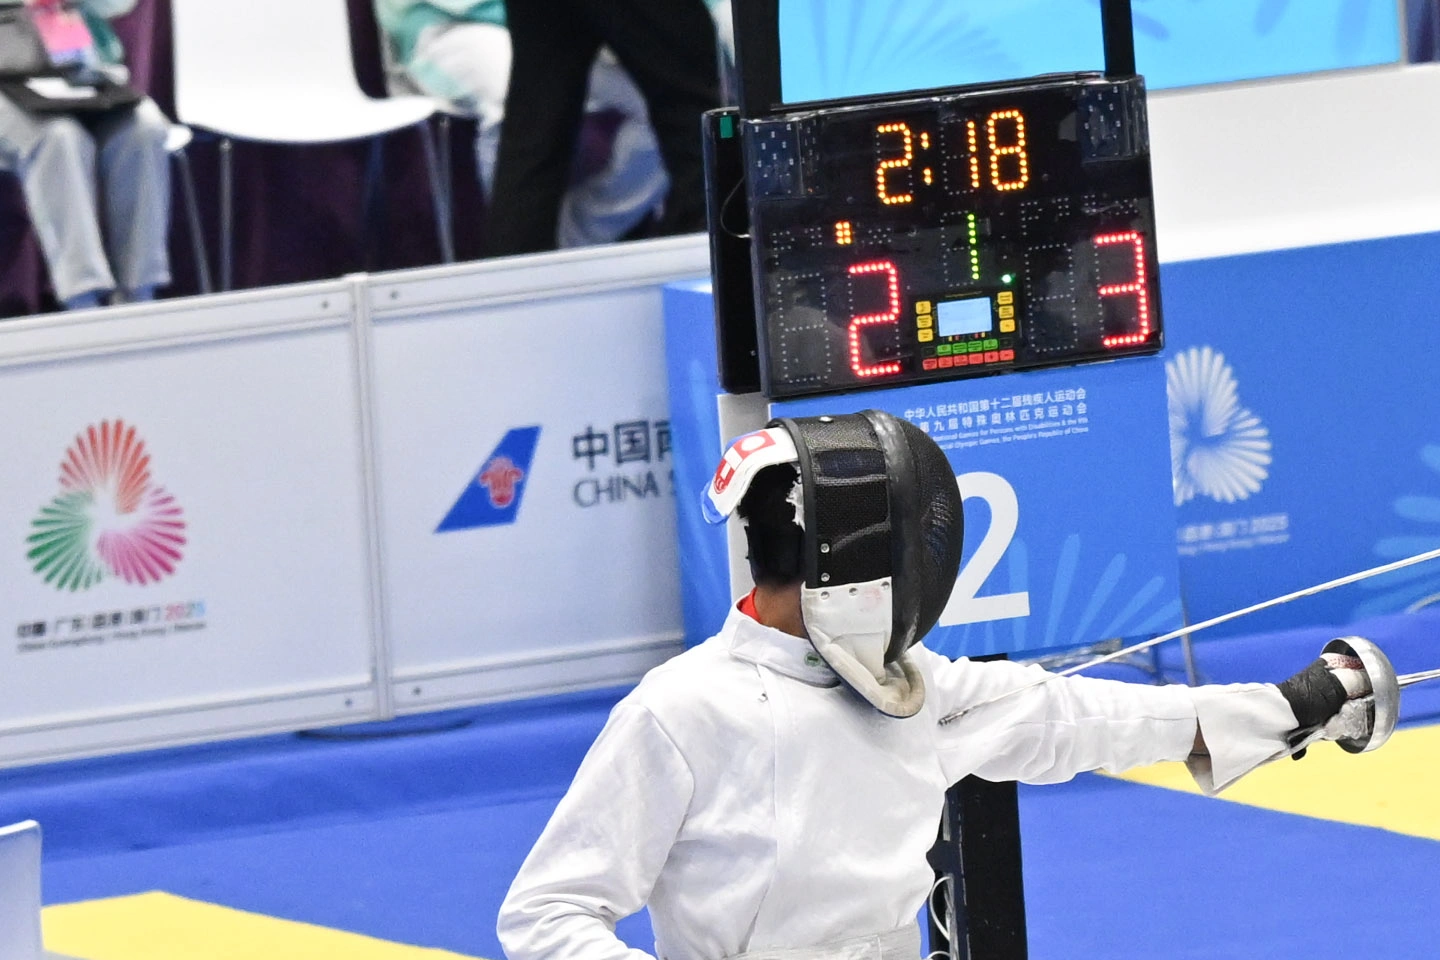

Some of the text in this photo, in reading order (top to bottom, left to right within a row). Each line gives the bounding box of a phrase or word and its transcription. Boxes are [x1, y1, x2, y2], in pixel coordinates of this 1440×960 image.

[876, 109, 1028, 205] 2:18
[848, 262, 902, 377] 2
[1095, 232, 1150, 347] 3
[573, 471, 660, 508] CHINA
[939, 470, 1031, 627] 2
